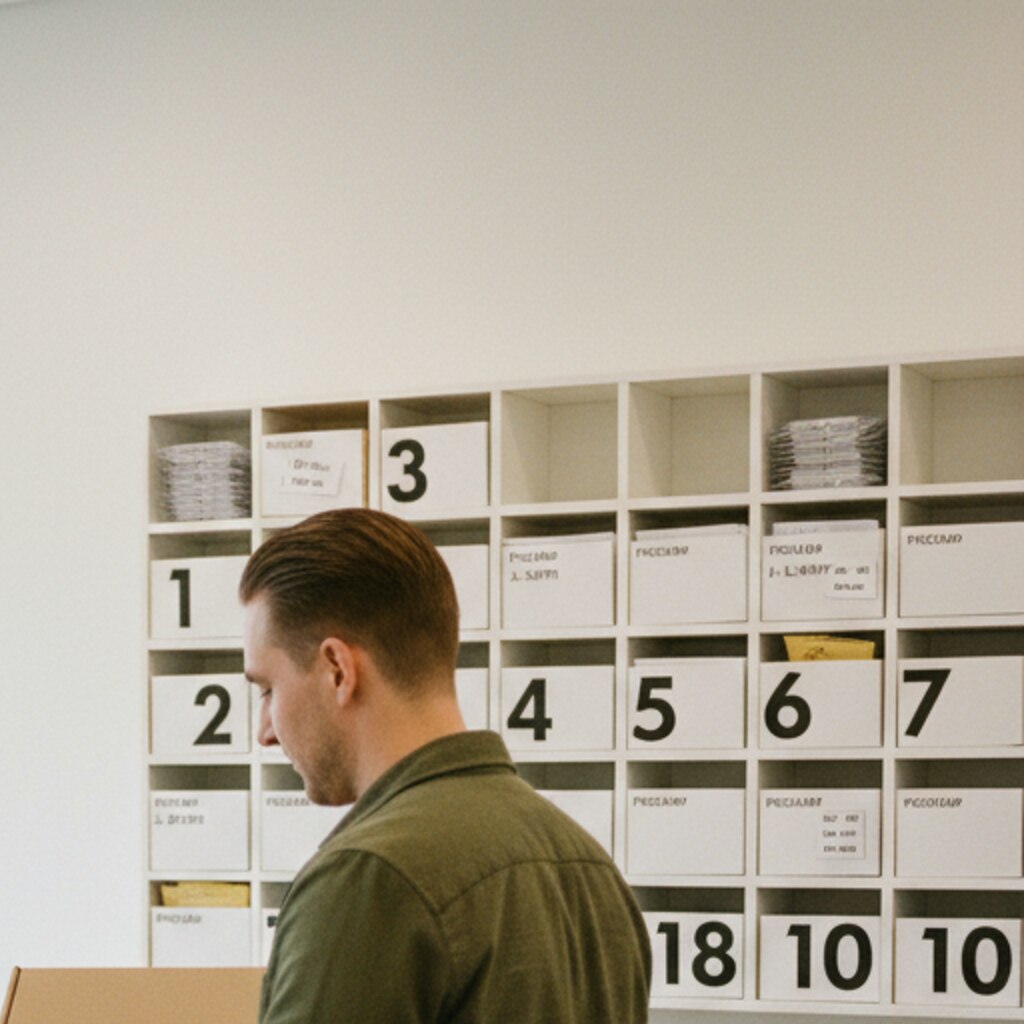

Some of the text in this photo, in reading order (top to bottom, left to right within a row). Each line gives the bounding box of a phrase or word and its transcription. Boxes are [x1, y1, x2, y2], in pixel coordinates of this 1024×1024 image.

[387, 439, 428, 503] 3
[169, 569, 191, 628] 1
[193, 684, 232, 746] 2
[507, 678, 553, 741] 4
[633, 676, 677, 742] 5
[764, 672, 812, 739] 6
[903, 669, 952, 738] 7
[657, 921, 737, 987] 18
[787, 923, 873, 991] 10
[922, 926, 1013, 996] 10
